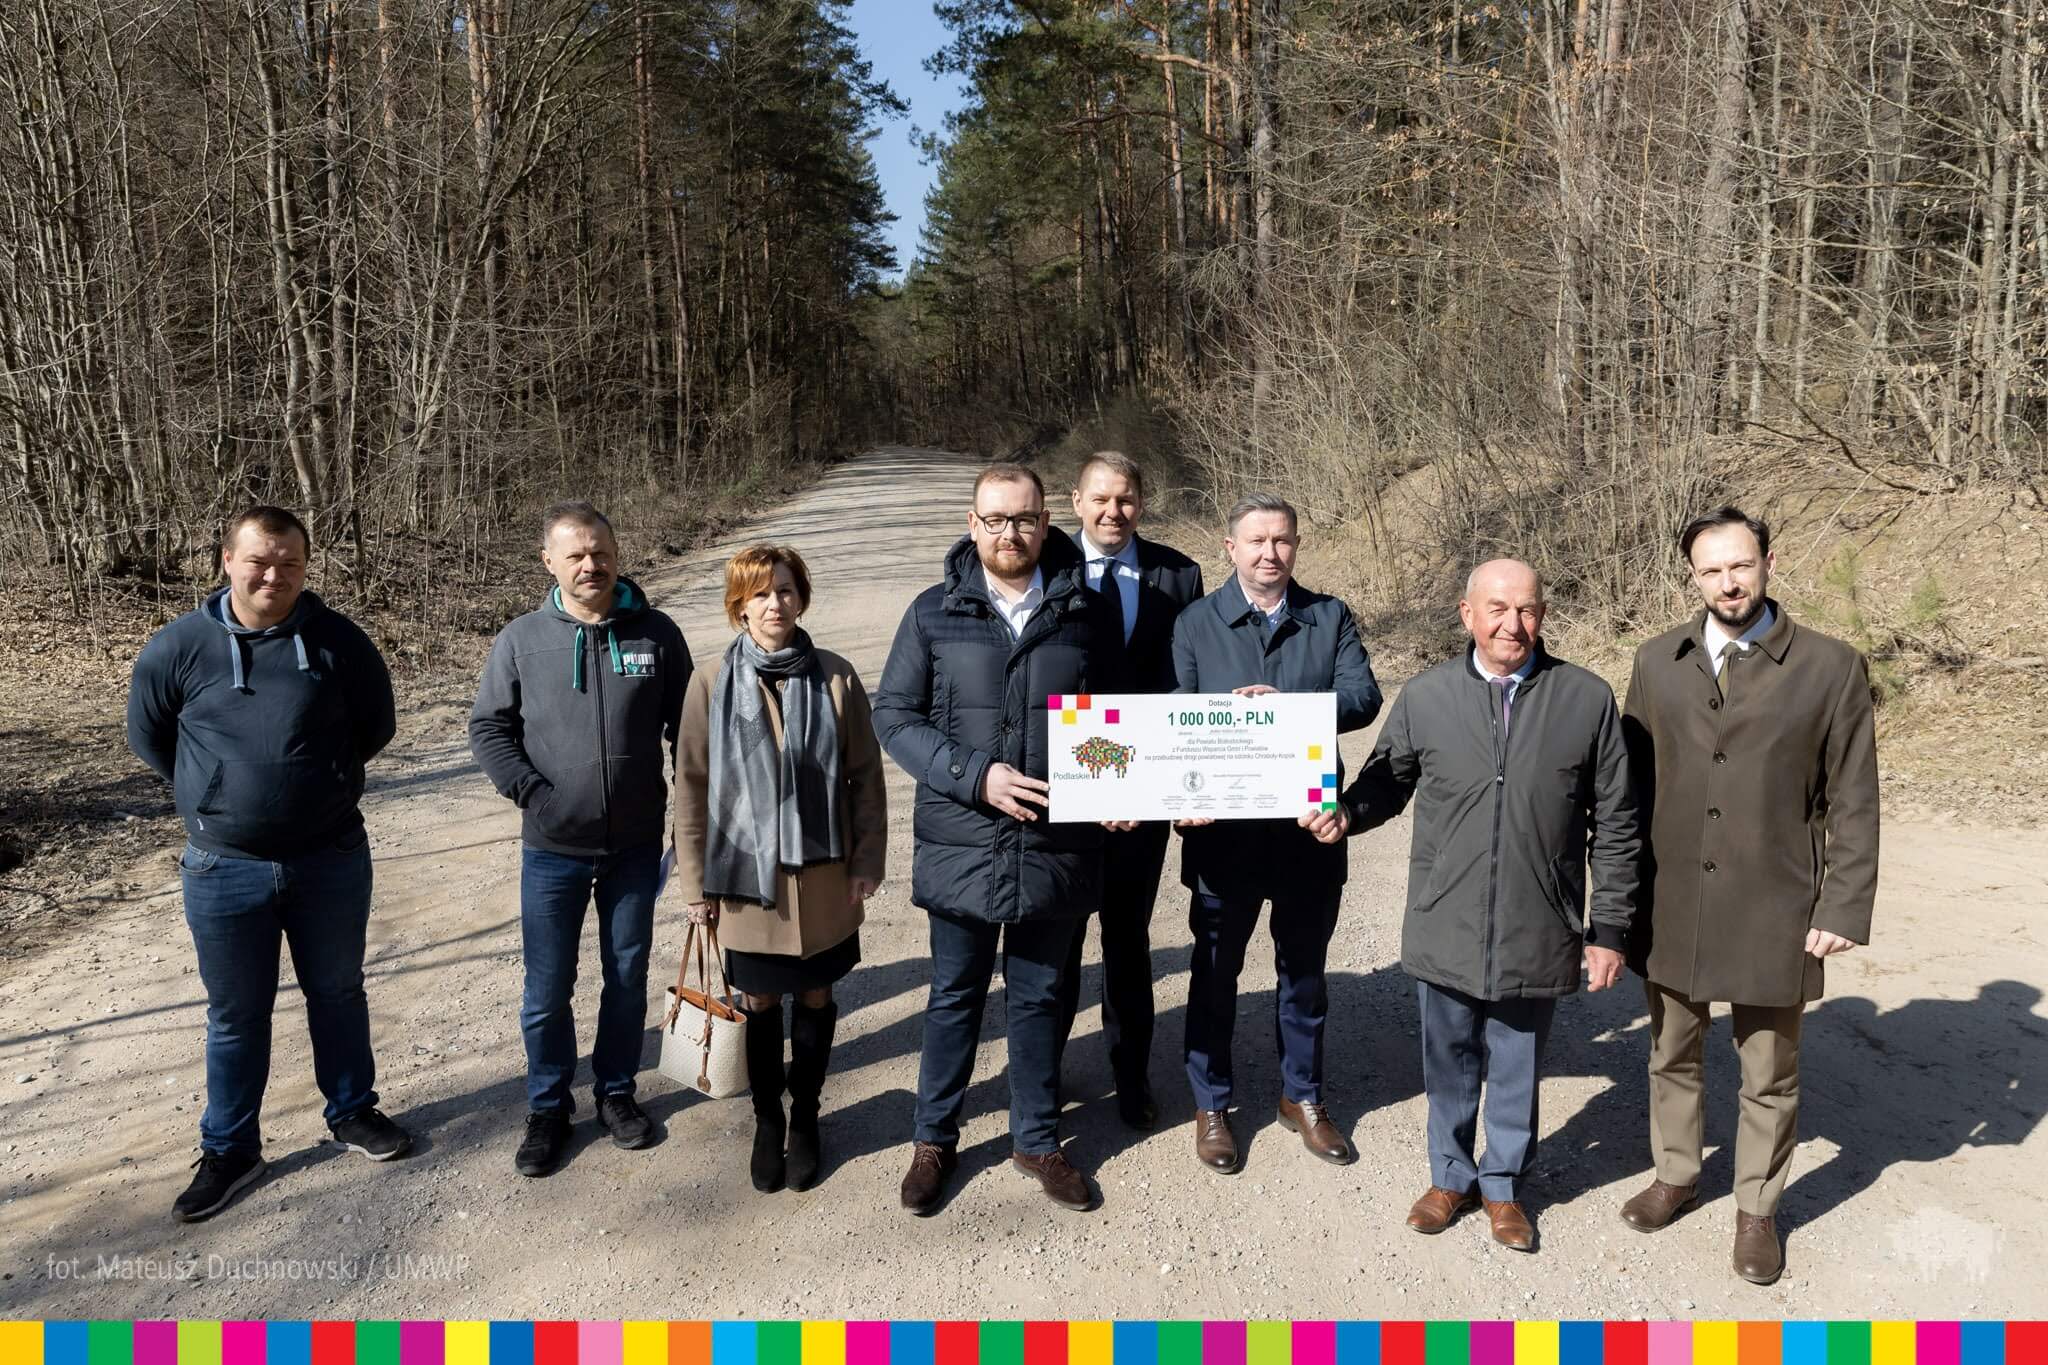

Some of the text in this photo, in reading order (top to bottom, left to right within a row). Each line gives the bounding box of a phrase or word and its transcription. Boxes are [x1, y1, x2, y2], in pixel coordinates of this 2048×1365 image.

[623, 653, 655, 665] PUMA
[1208, 699, 1232, 708] Dotacja
[1167, 712, 1174, 726] 1
[1180, 712, 1204, 726] 000
[1246, 711, 1274, 725] PLN
[1053, 772, 1090, 780] Podlaskie
